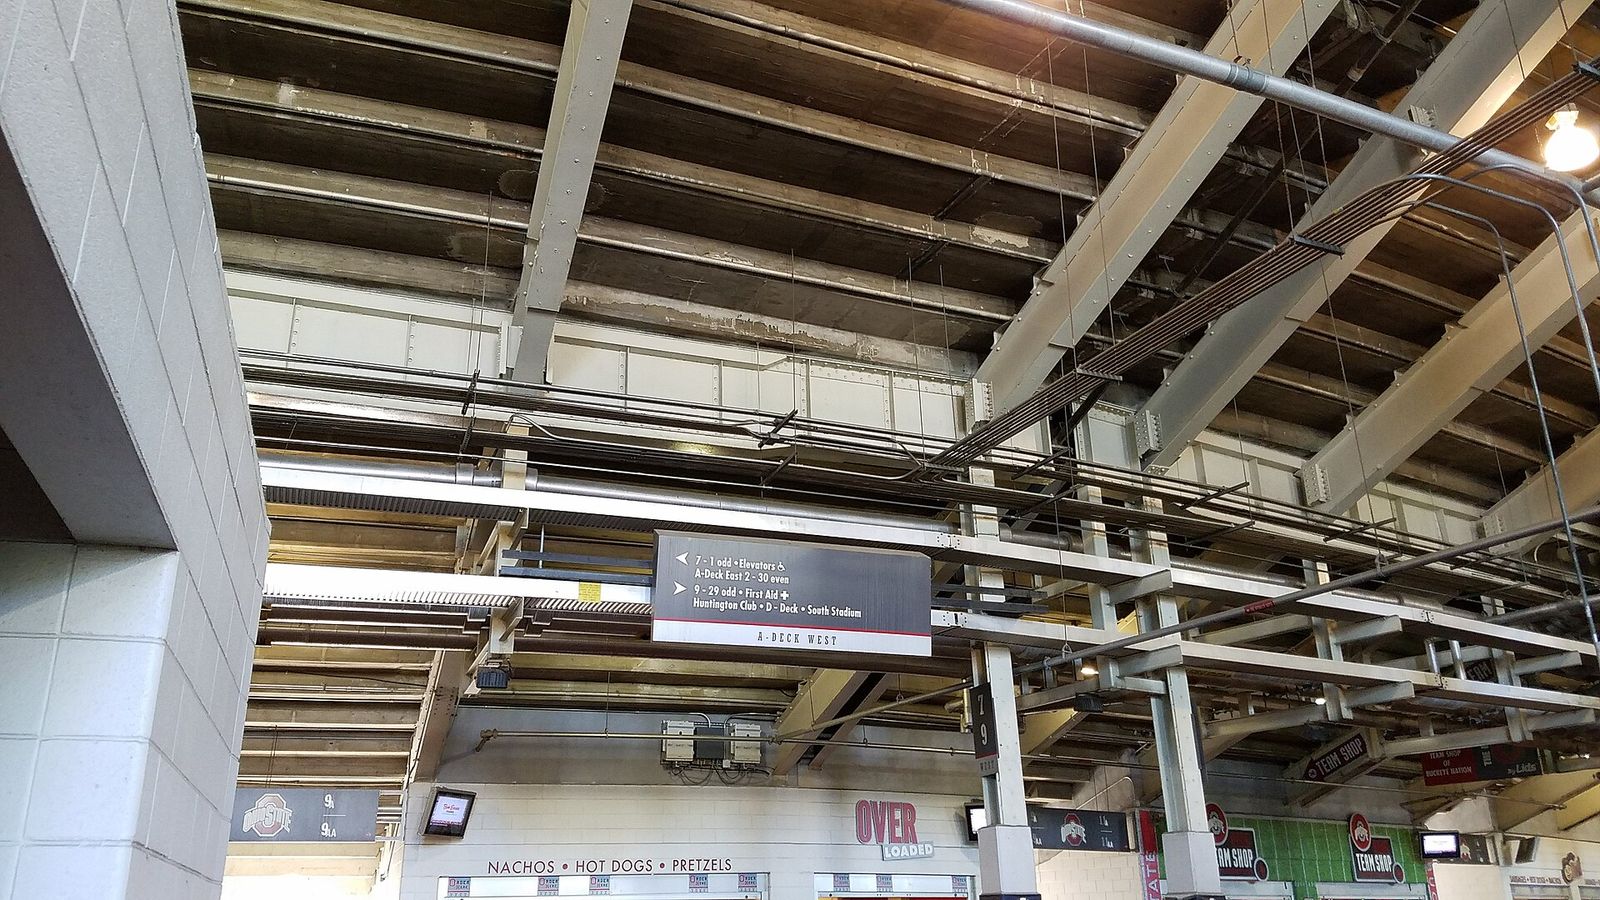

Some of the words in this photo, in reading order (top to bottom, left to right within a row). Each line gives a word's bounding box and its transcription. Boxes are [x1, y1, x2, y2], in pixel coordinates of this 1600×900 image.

[695, 555, 702, 565] 7
[710, 556, 714, 566] 1
[717, 557, 732, 568] odd
[739, 558, 776, 571] Elevators
[694, 568, 724, 580] A-Deck
[725, 570, 743, 580] East
[744, 571, 751, 582] 2
[758, 572, 769, 583] 30
[770, 575, 790, 584] even
[694, 584, 700, 595] 9
[708, 585, 720, 596] 29
[721, 586, 737, 597] odd
[745, 588, 763, 599] First
[765, 589, 779, 600] Aid
[693, 597, 738, 612] Huntington
[740, 600, 757, 611] Club
[766, 602, 773, 612] D
[780, 603, 799, 614] Deck
[807, 604, 829, 616] South
[831, 606, 862, 618] Stadium
[757, 631, 800, 644] A-DECK
[807, 634, 837, 646] WEST
[977, 694, 985, 715] 7
[980, 723, 989, 746] 9
[1315, 751, 1342, 776] TEAM
[1340, 738, 1363, 761] SHOP
[1429, 750, 1445, 760] TEAM
[1446, 749, 1461, 758] SHOP
[1425, 768, 1450, 778] BUCKEYE
[1450, 766, 1472, 776] NATION
[1515, 762, 1537, 774] Lids
[855, 799, 919, 845] OVER
[884, 844, 933, 859] LOADED
[1217, 848, 1232, 868] AM
[1231, 848, 1253, 869] SHOP
[487, 860, 555, 874] NACHOS
[575, 860, 606, 873] HOT
[611, 859, 653, 873] DOGS
[672, 858, 732, 872] PRETZELS
[1355, 853, 1376, 872] TEAM
[1374, 854, 1392, 873] SHOP
